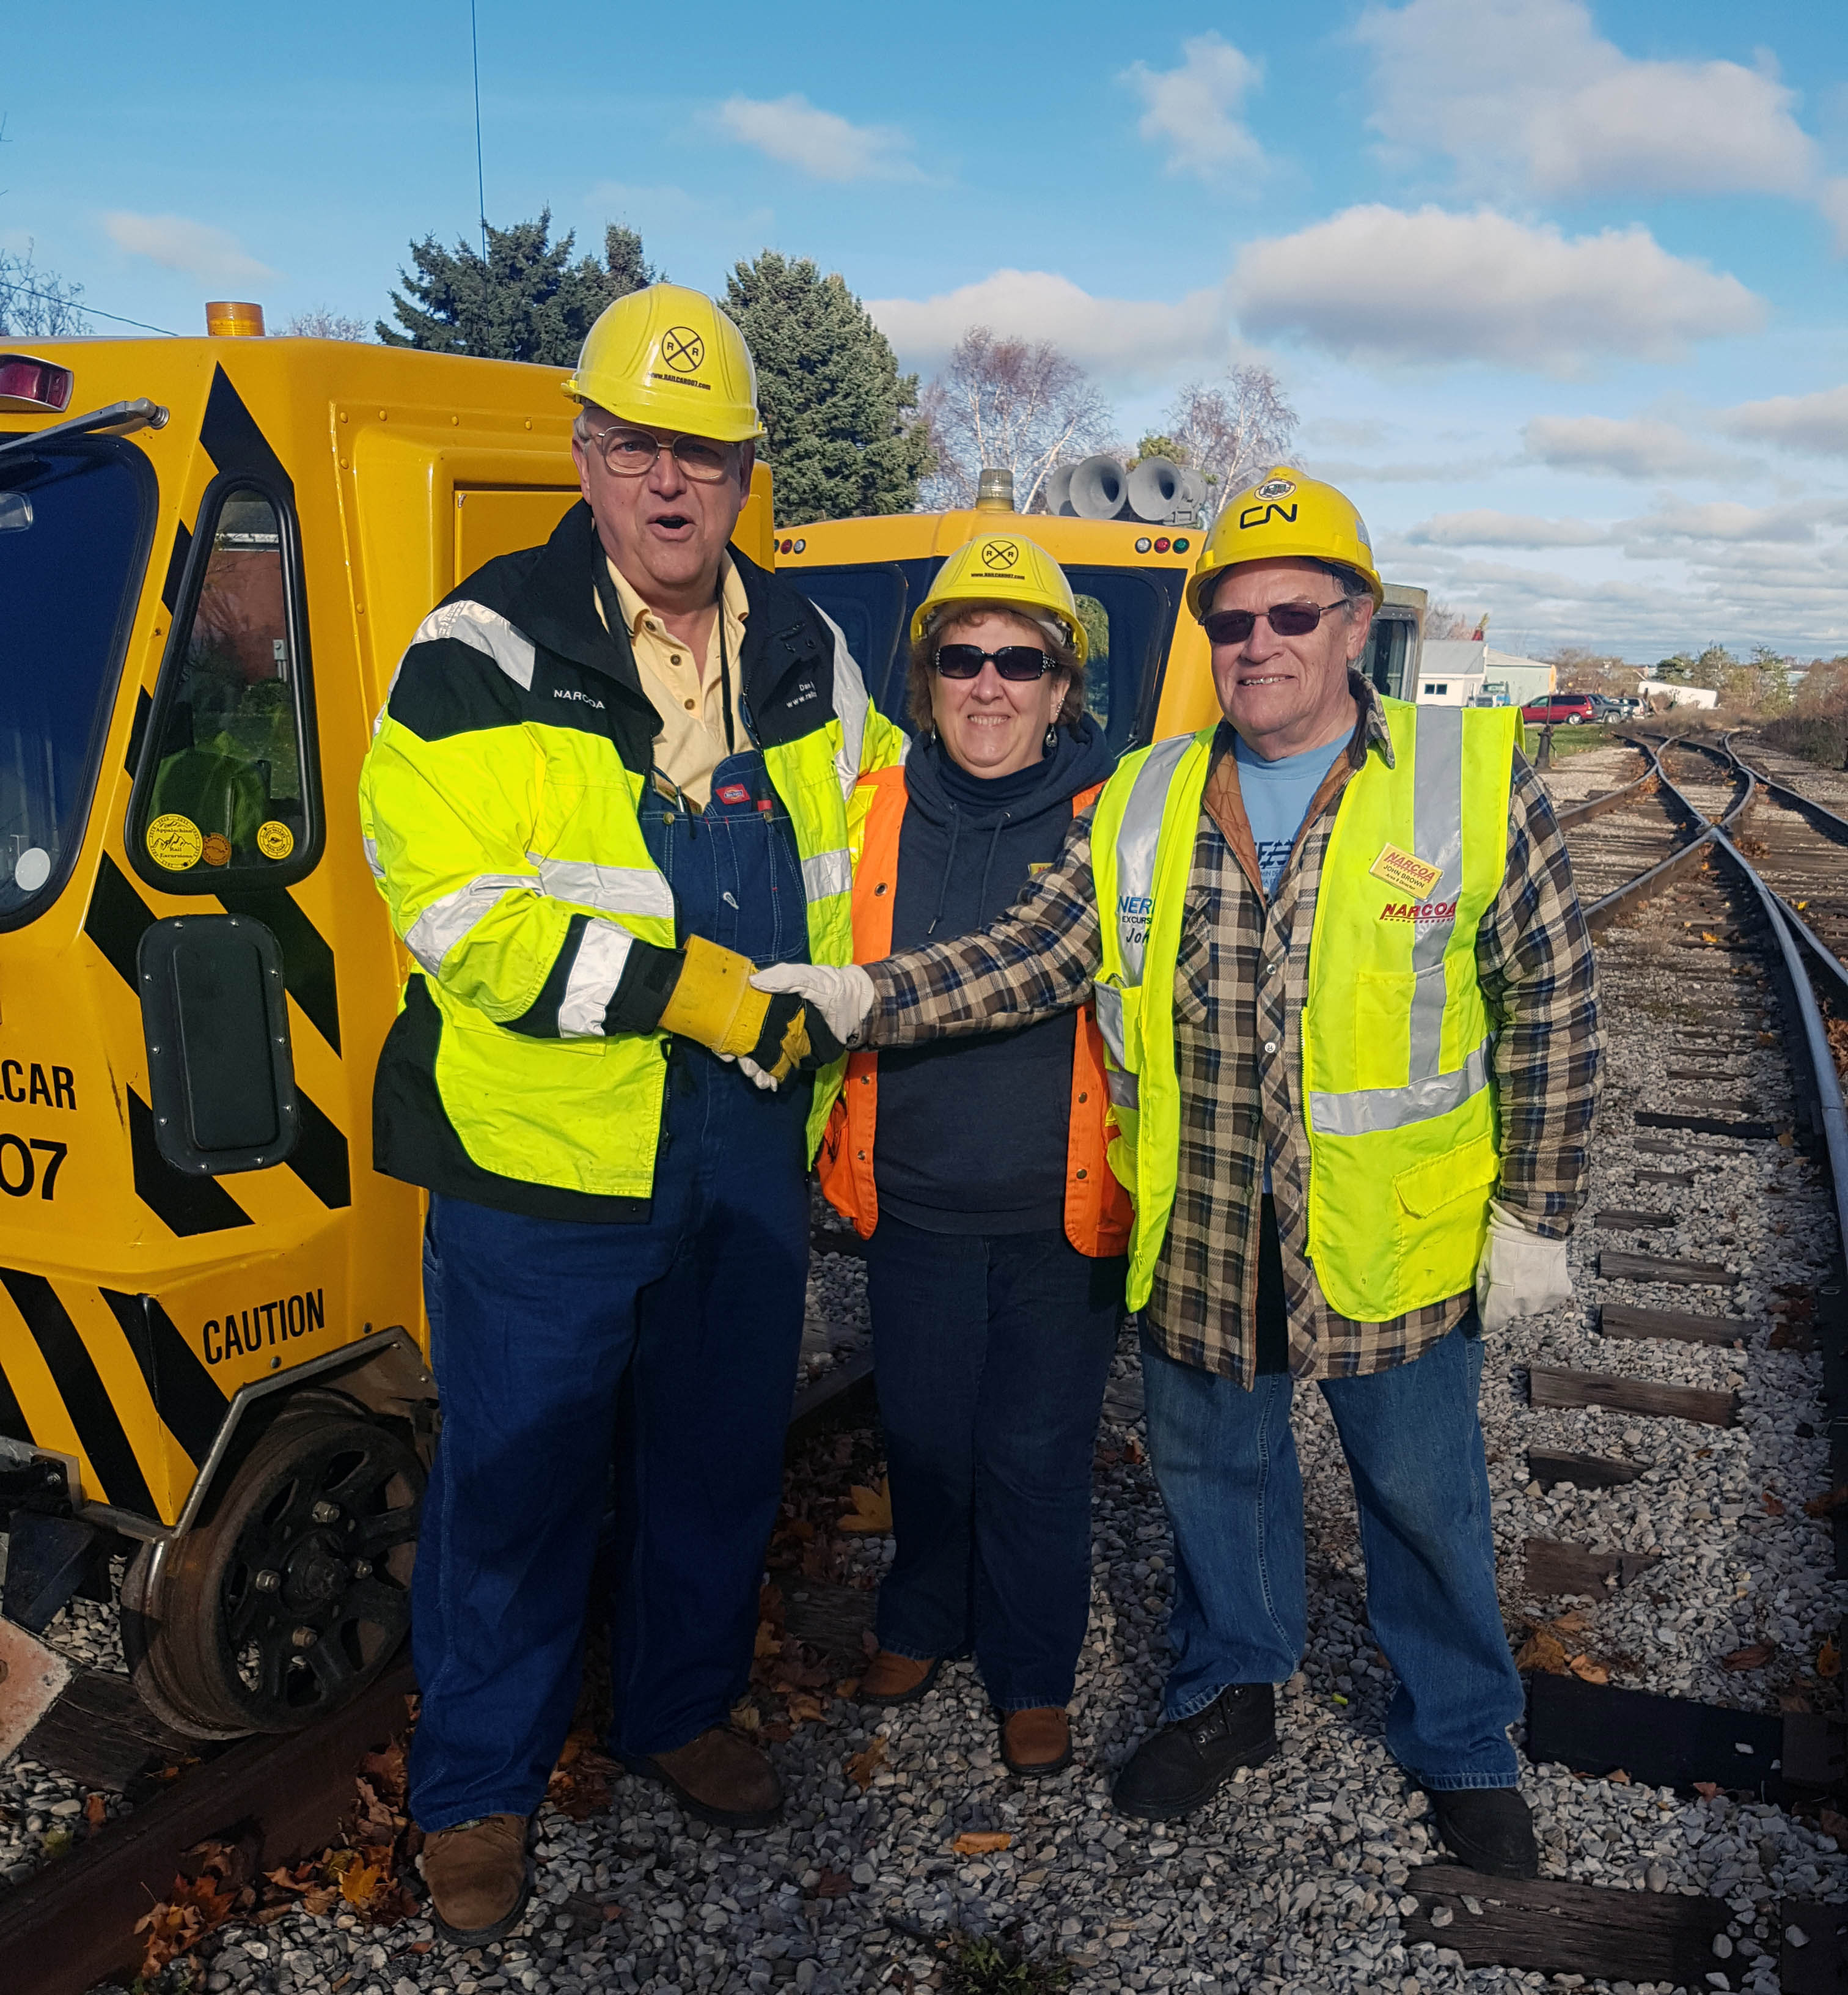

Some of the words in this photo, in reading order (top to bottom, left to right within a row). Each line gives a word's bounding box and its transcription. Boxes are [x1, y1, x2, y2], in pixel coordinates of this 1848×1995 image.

[667, 342, 674, 351] R
[692, 347, 699, 356] R
[1239, 504, 1297, 529] CN
[554, 689, 606, 709] NARCOA
[1383, 864, 1401, 876] JOHN
[1401, 873, 1425, 888] BROWN
[1384, 852, 1436, 883] NARCOA
[1379, 902, 1457, 920] NARCOA
[0, 1059, 78, 1110] CAR
[0, 1133, 68, 1201] 07
[203, 1288, 325, 1365] CAUTION
